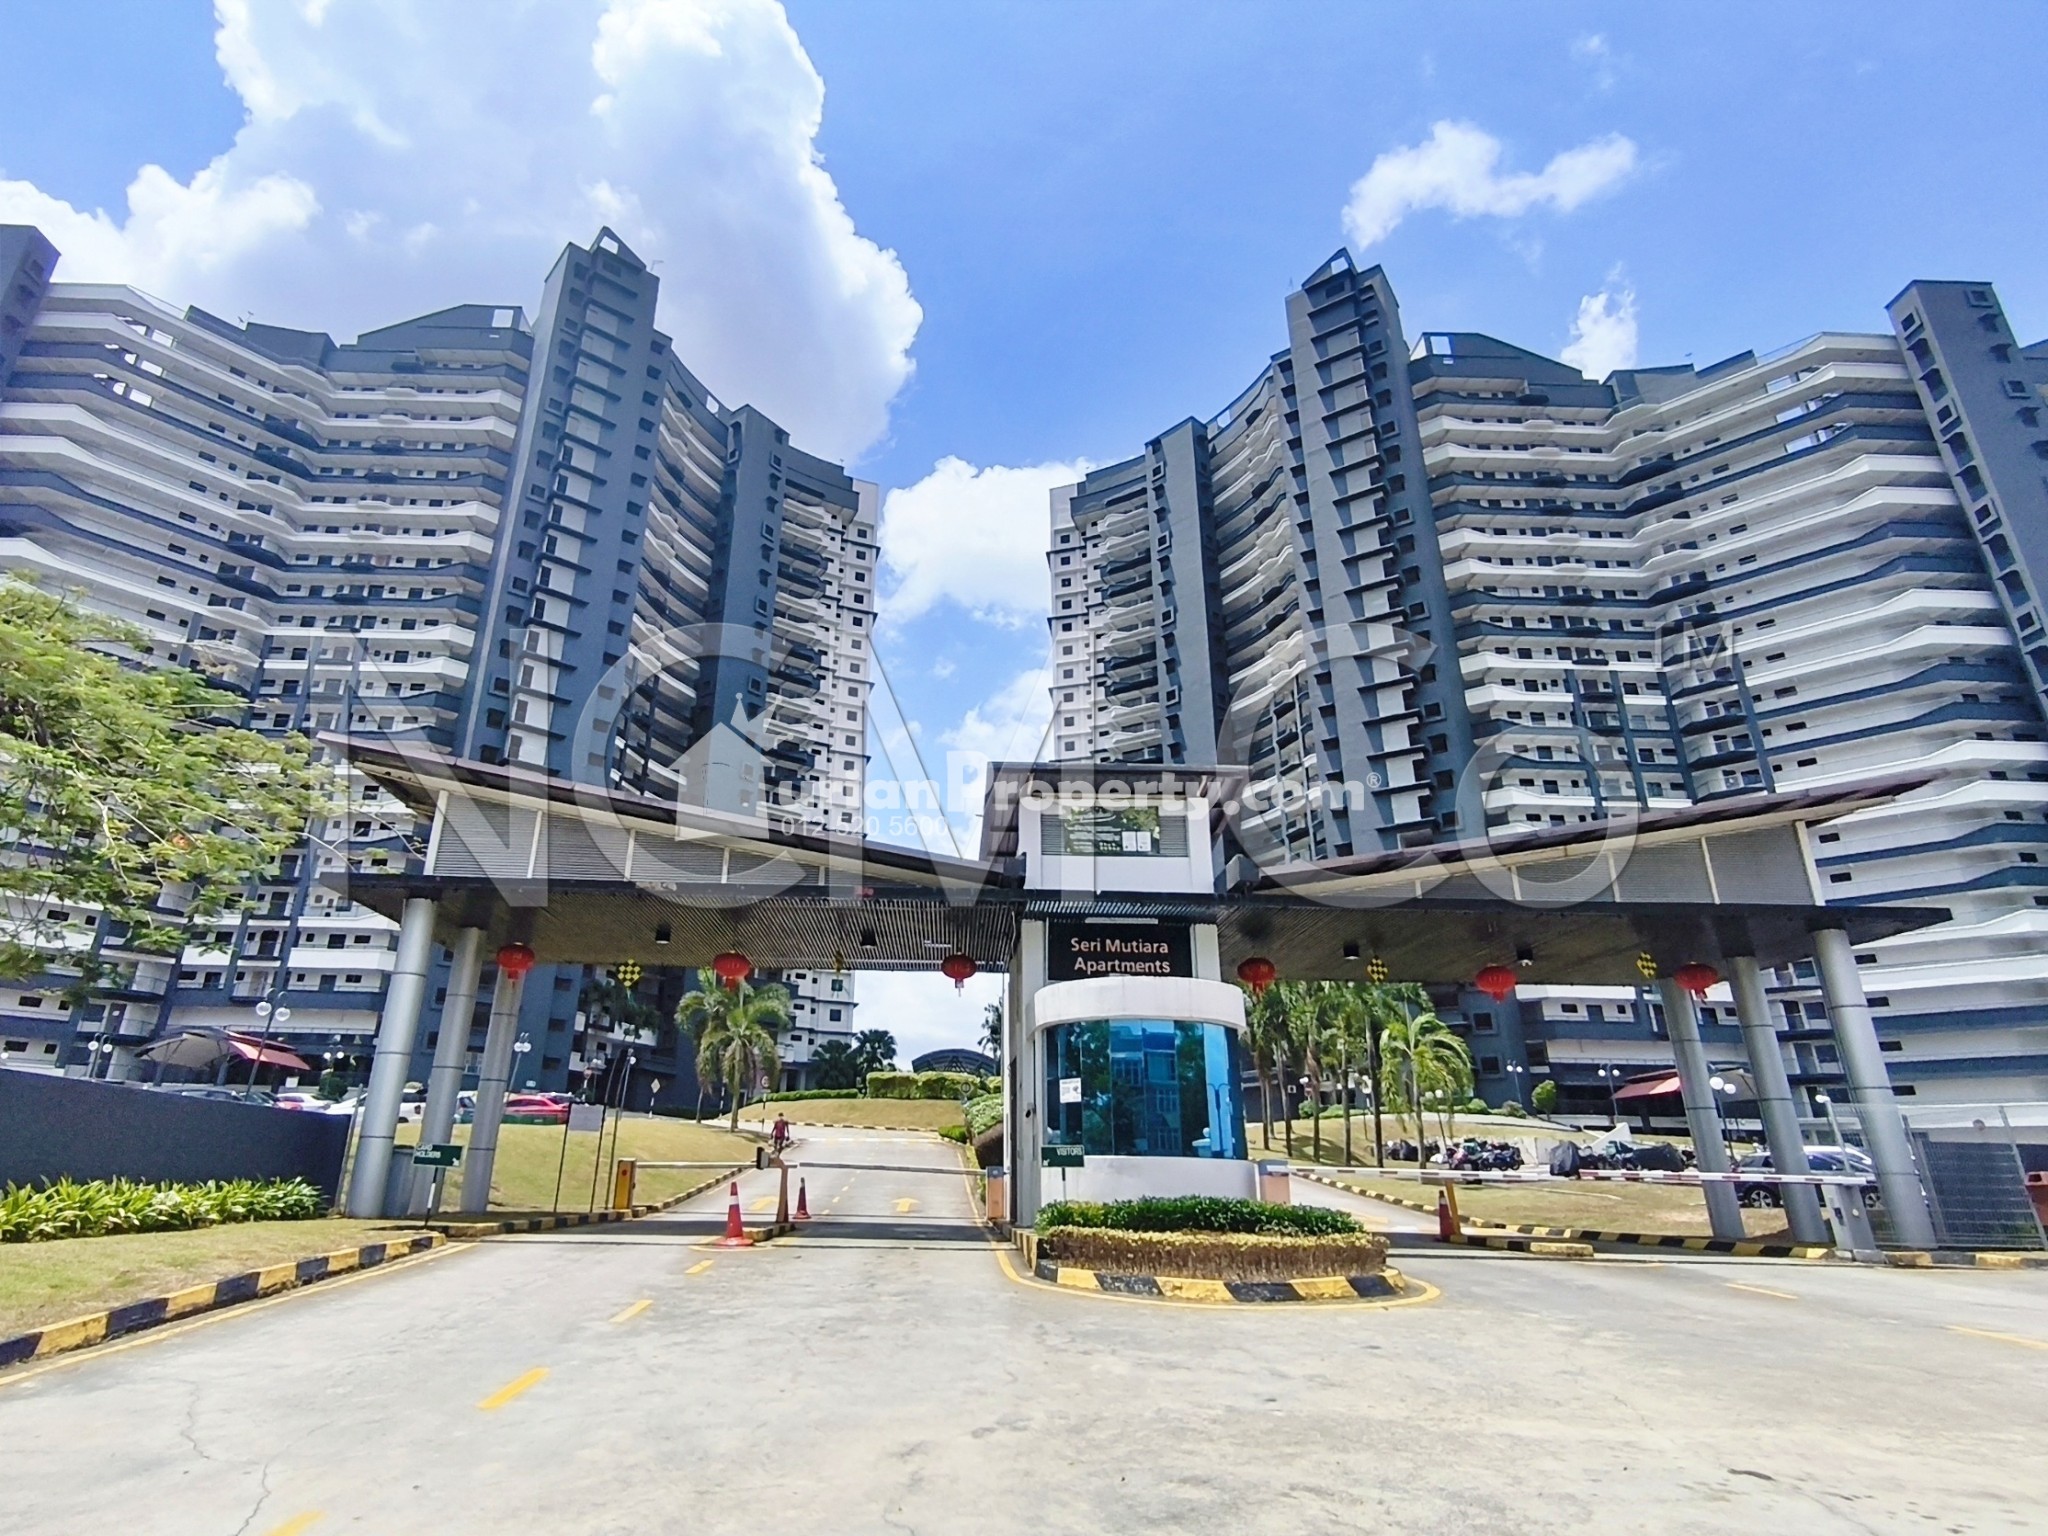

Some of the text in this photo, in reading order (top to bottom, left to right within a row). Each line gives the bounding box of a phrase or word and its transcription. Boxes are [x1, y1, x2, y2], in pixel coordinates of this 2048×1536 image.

[1070, 937, 1169, 954] Seri Mutiara
[1074, 956, 1171, 975] Apartments
[1056, 1147, 1083, 1156] VISITORS
